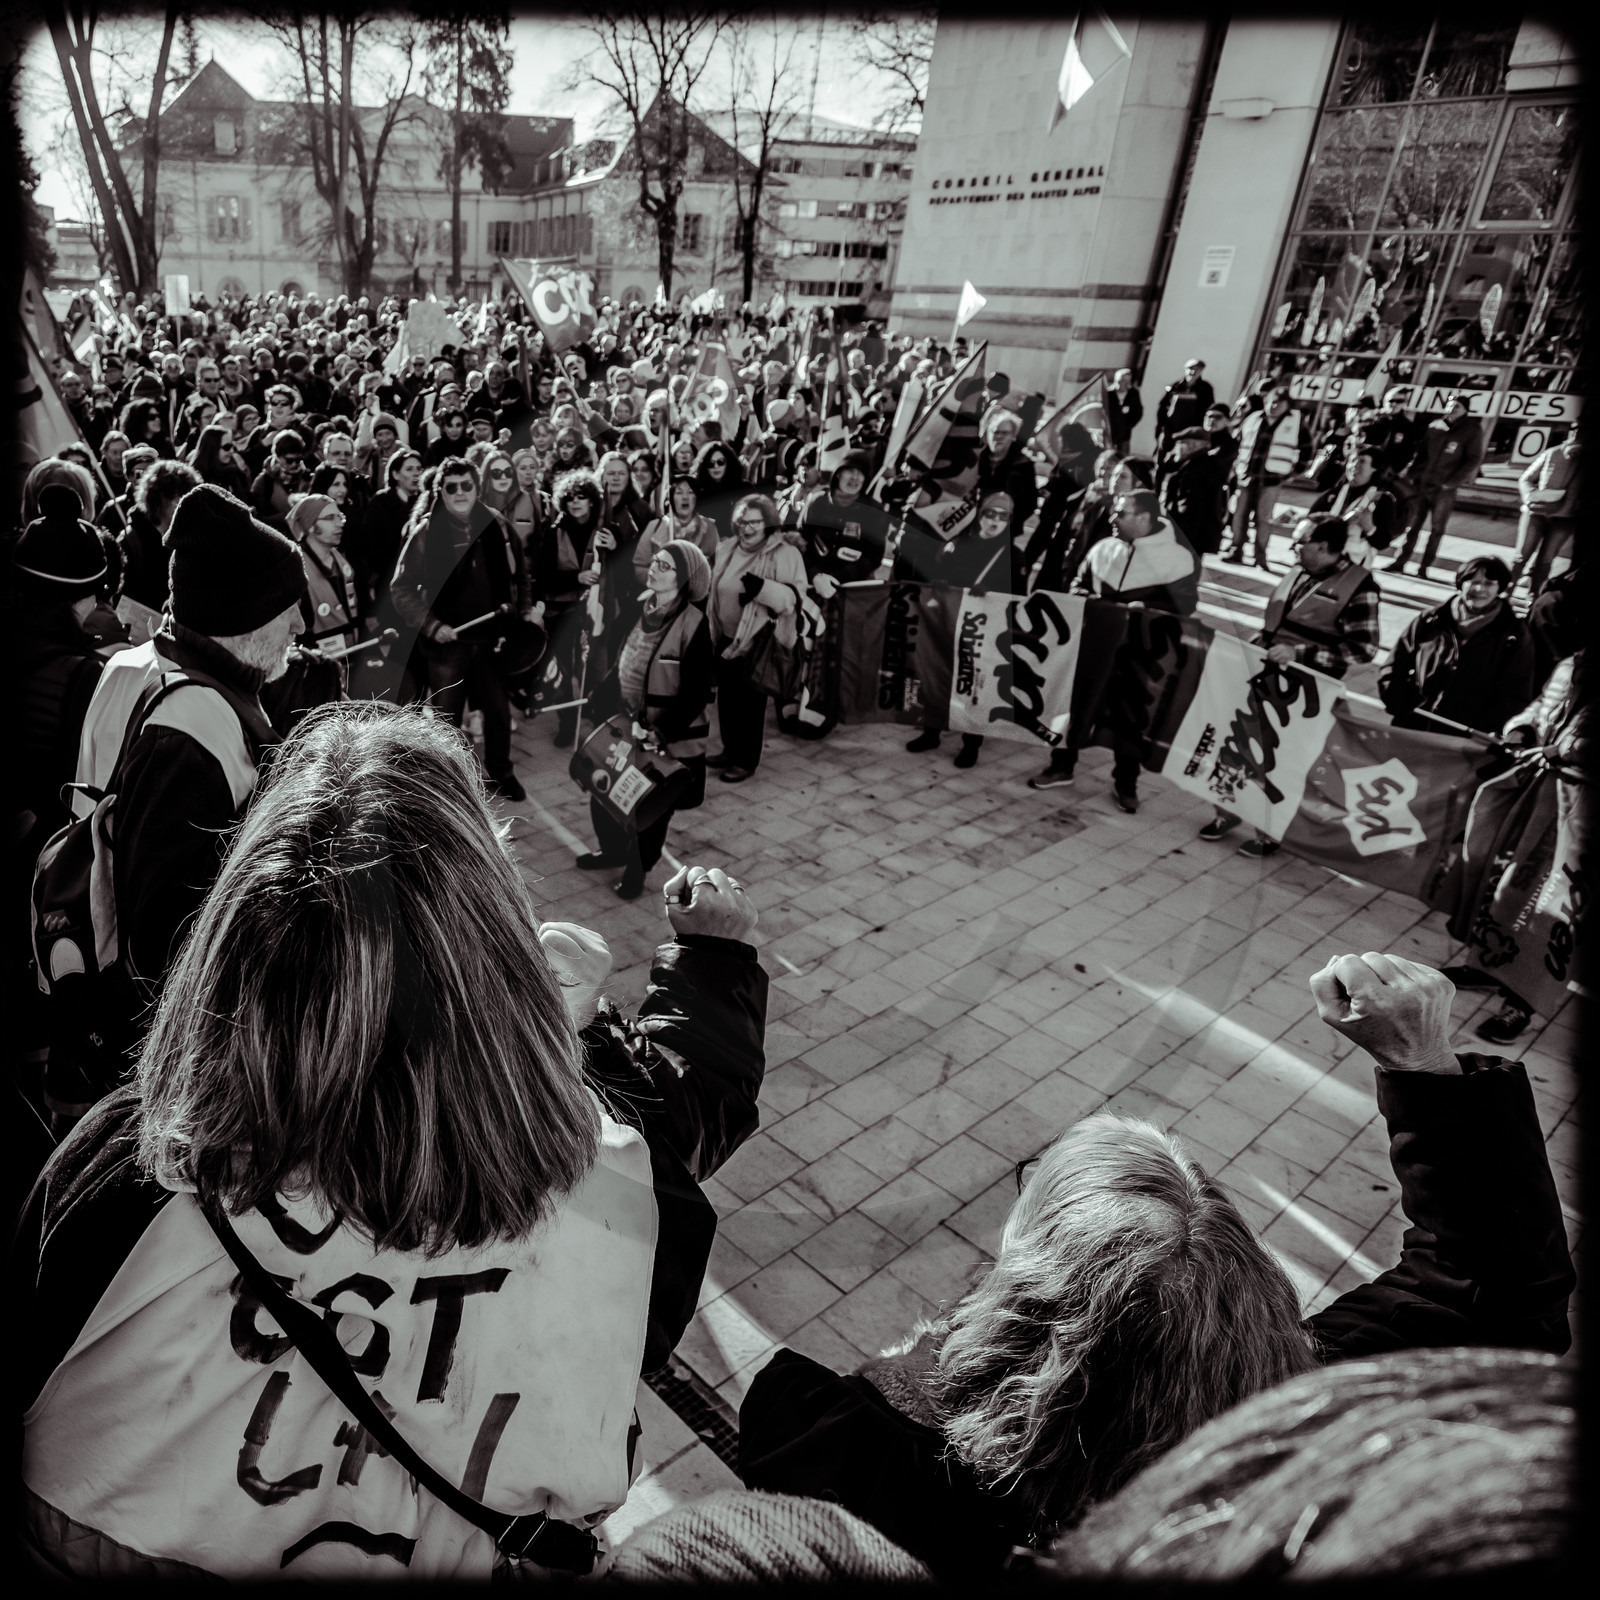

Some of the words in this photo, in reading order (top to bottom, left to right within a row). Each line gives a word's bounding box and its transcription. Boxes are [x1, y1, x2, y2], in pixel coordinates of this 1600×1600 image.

[931, 174, 1014, 190] CONSEIL
[1072, 185, 1101, 197] ALPES
[1293, 377, 1344, 400] 149
[955, 610, 988, 697] Solidaires
